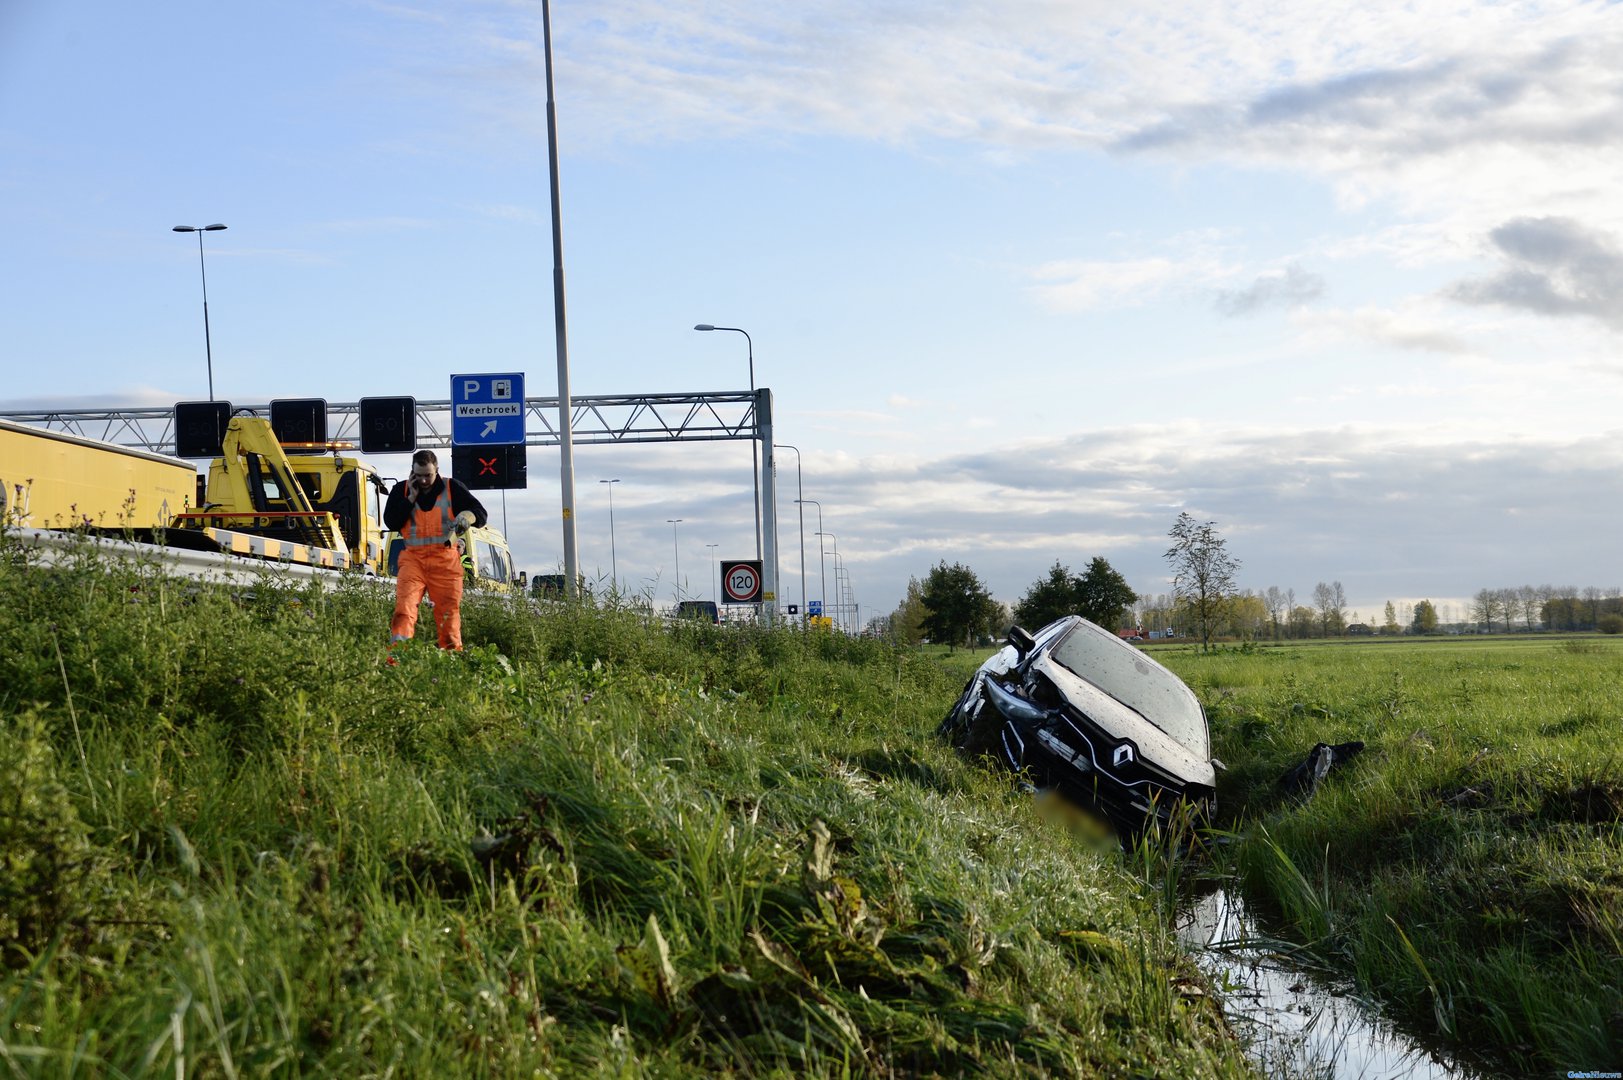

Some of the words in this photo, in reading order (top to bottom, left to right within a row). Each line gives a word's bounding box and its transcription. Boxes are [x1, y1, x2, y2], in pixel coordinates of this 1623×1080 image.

[464, 380, 480, 400] P
[459, 405, 517, 415] Weerbroek
[732, 576, 753, 589] 120
